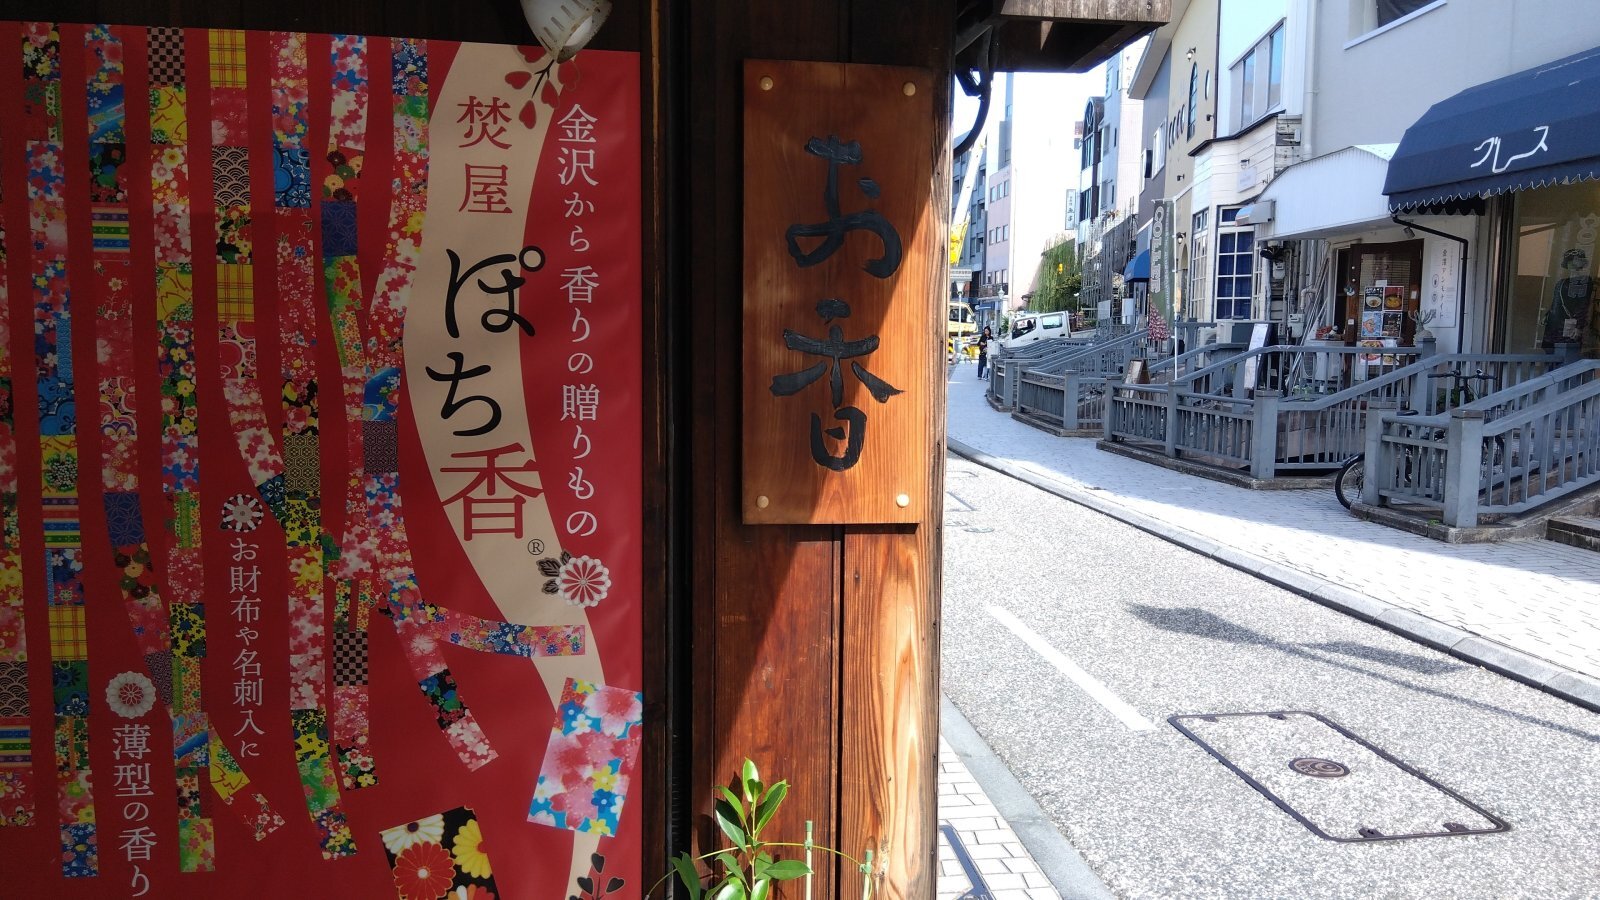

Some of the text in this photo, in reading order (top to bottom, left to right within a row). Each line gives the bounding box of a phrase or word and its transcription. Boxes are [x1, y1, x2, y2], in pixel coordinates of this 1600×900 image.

[457, 96, 512, 213] 焚屋
[425, 246, 546, 541] ぽち香
[557, 103, 600, 537] 金沢から香りの贈りもの
[769, 134, 906, 472] お香
[229, 537, 265, 758] お財布や名刺入に
[112, 723, 158, 897] 薄型の香り
